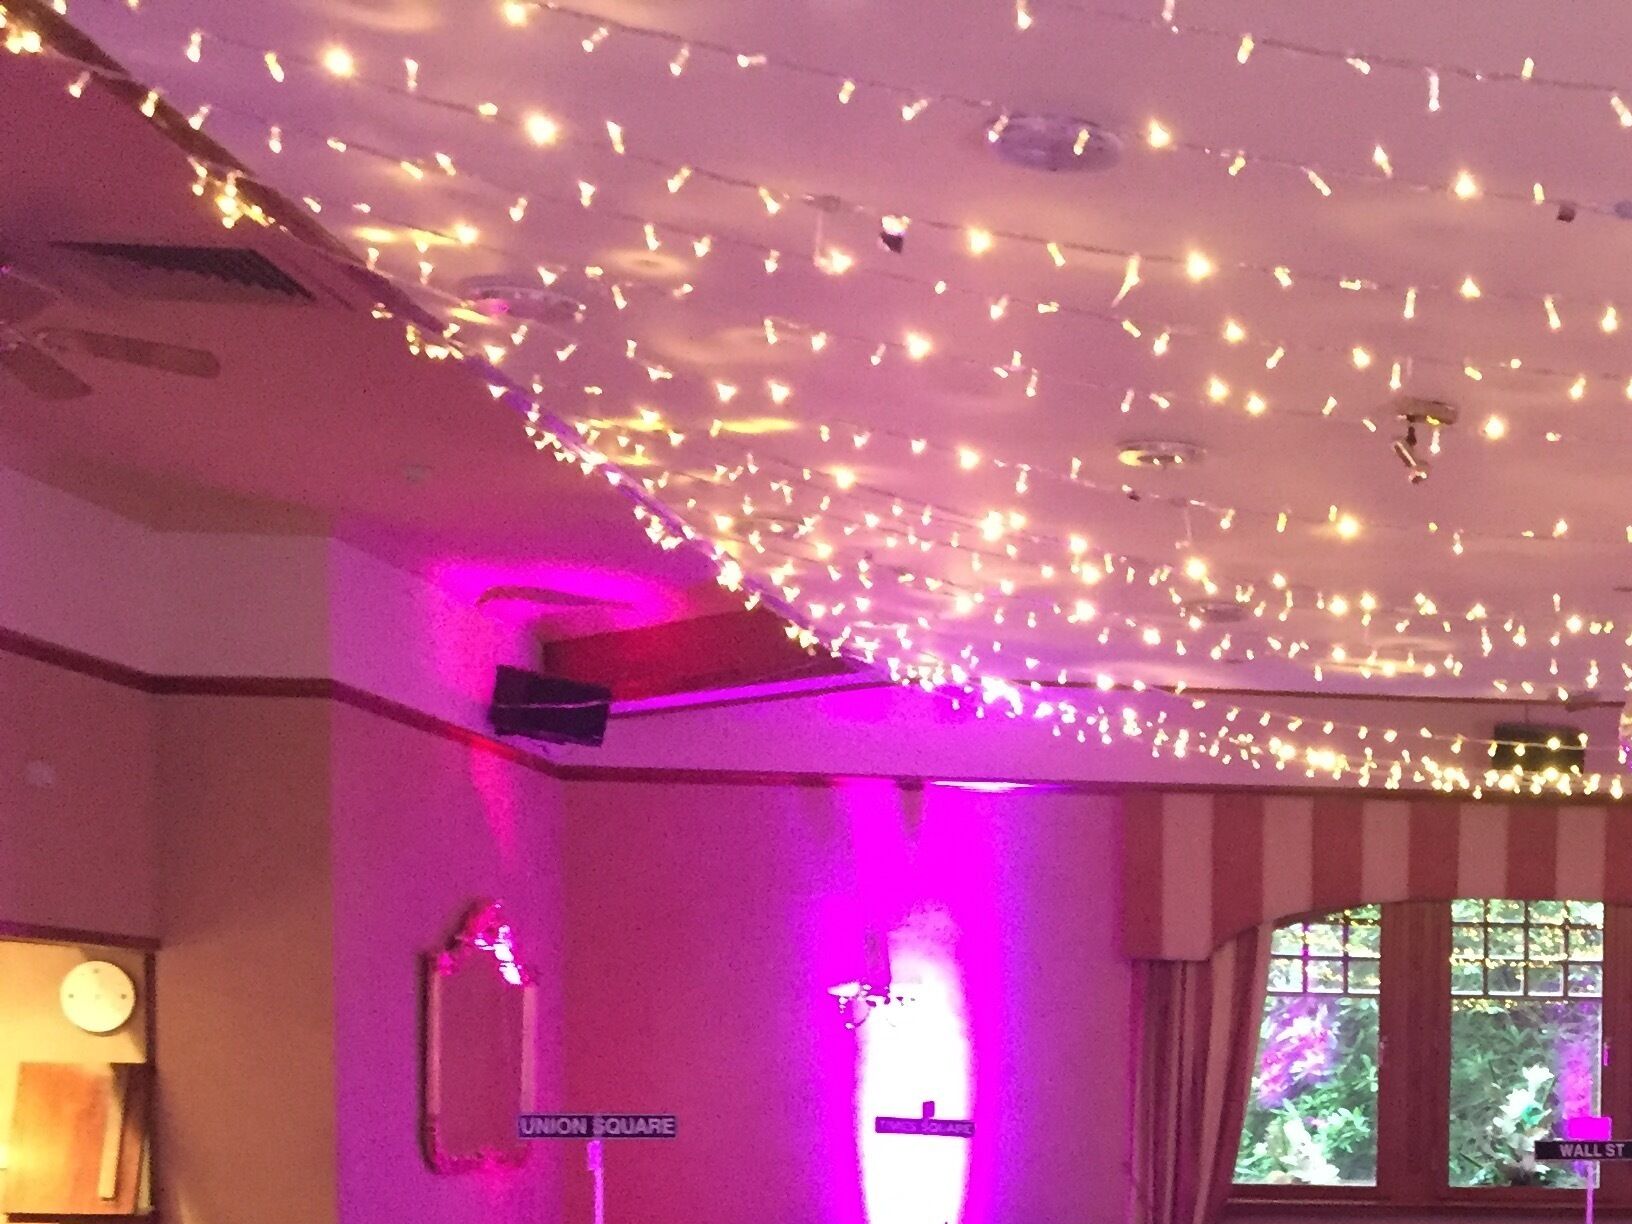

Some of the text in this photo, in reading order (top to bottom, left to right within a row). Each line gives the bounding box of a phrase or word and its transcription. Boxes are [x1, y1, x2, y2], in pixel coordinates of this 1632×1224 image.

[519, 1117, 676, 1135] UNION SQUARE
[1559, 1143, 1625, 1158] WALL ST
